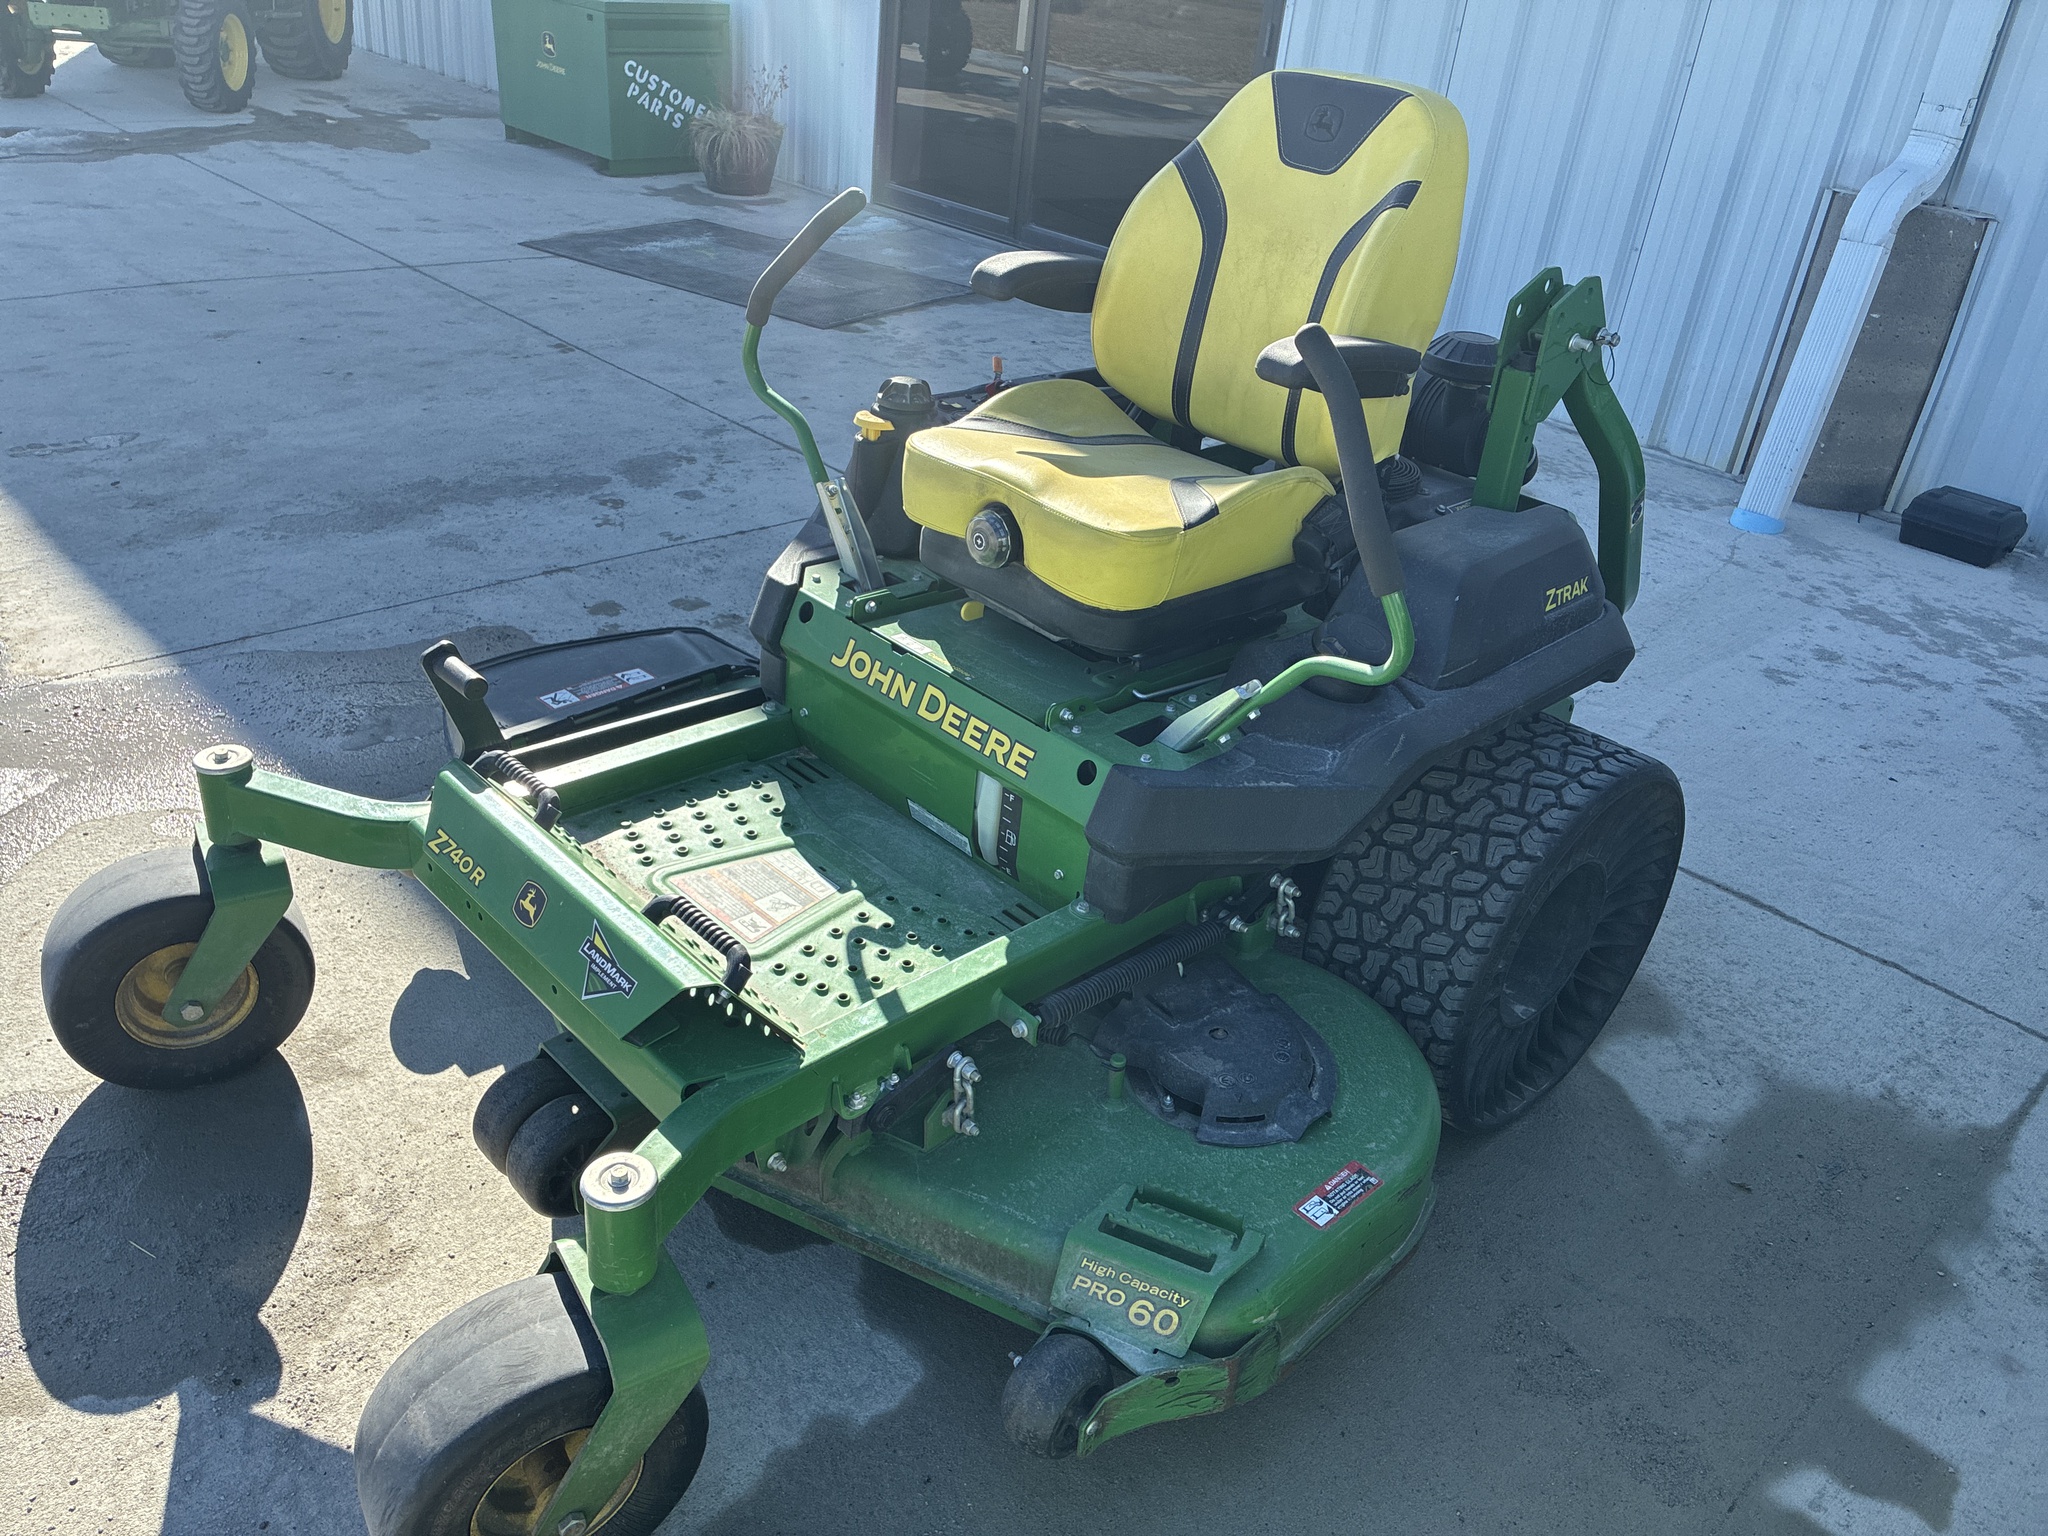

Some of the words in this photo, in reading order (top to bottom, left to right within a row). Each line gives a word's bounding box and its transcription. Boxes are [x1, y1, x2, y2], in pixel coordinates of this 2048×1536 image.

[627, 82, 684, 128] PARTS
[1544, 576, 1589, 612] ZTRAK
[830, 638, 917, 708] JOHN
[917, 684, 1037, 779] DEERE
[1009, 793, 1015, 802] F
[583, 942, 633, 992] LANDMARK
[590, 962, 617, 989] IMPLEMENT
[1071, 1274, 1126, 1306] PRO
[1128, 1299, 1179, 1336] 60
[1080, 1257, 1116, 1279] High
[1119, 1272, 1191, 1308] Capacity
